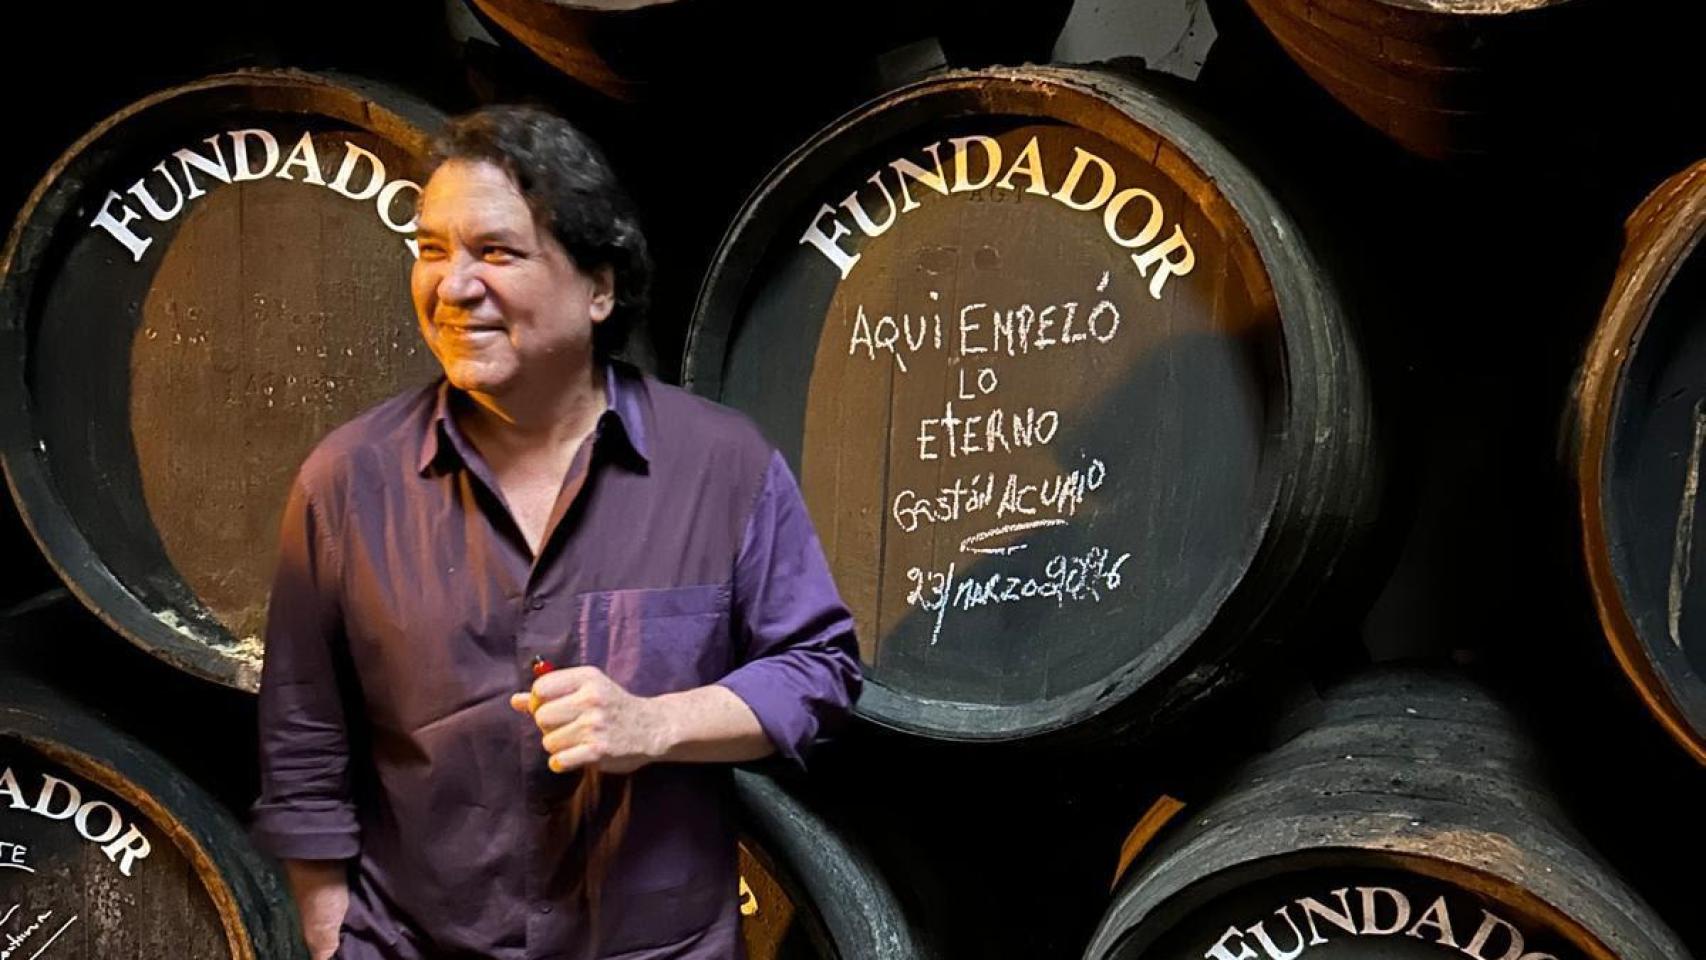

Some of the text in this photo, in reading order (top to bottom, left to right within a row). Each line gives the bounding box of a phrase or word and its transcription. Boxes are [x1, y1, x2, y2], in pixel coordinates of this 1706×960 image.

[90, 128, 423, 262] FUNDADO
[799, 134, 1196, 300] FUNDADOR
[959, 367, 998, 399] LO
